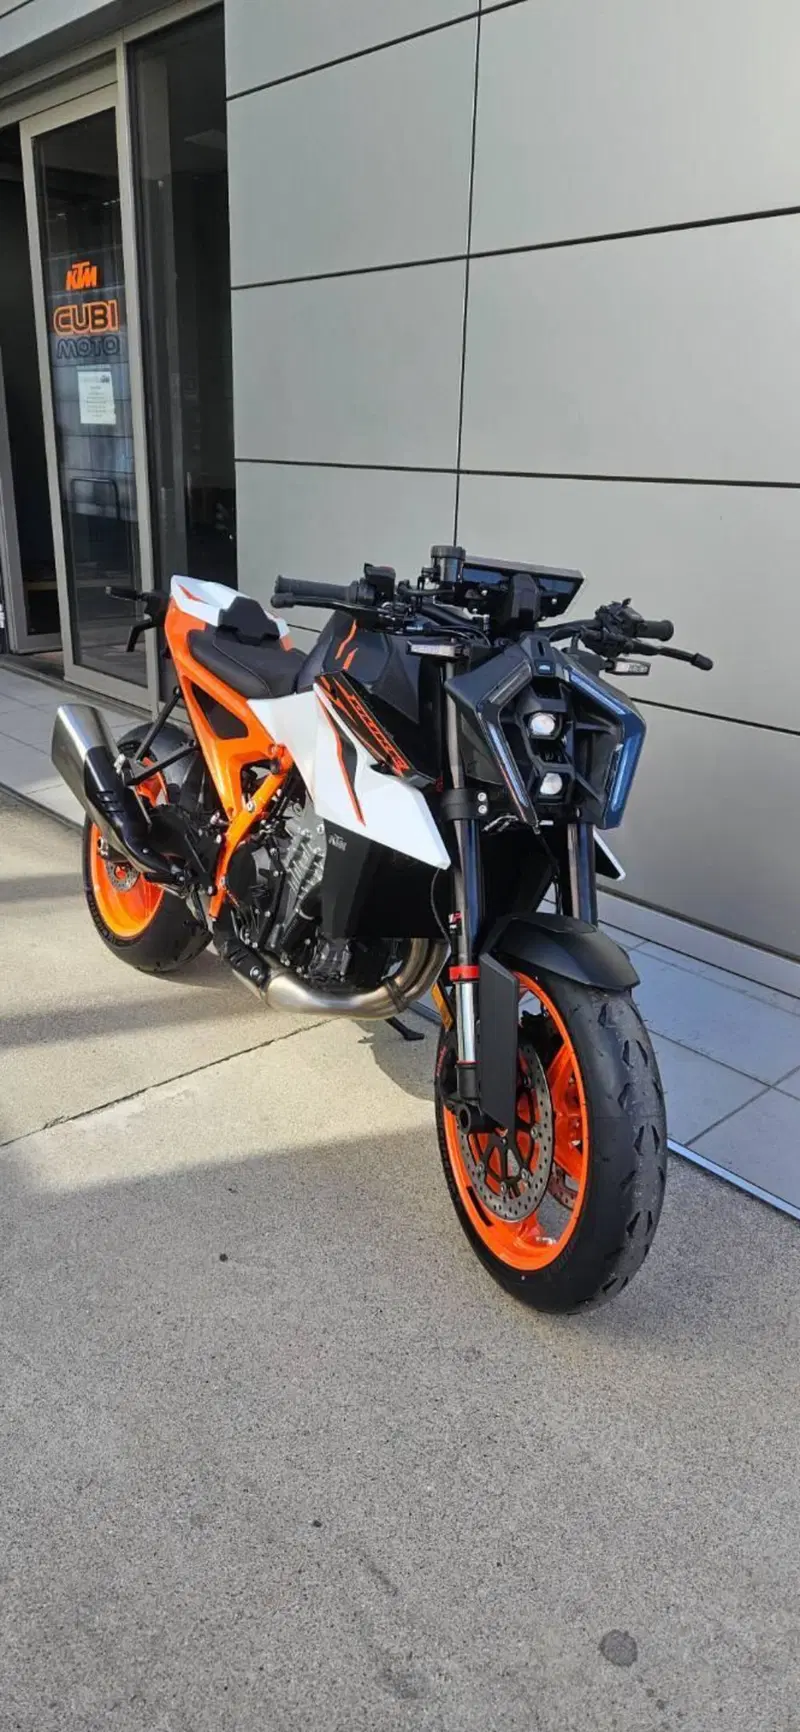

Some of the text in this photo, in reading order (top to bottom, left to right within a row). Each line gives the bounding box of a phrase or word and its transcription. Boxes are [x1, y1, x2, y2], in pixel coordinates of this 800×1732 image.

[65, 260, 98, 291] KTM
[53, 299, 120, 336] CUBI
[56, 333, 121, 360] MOTO
